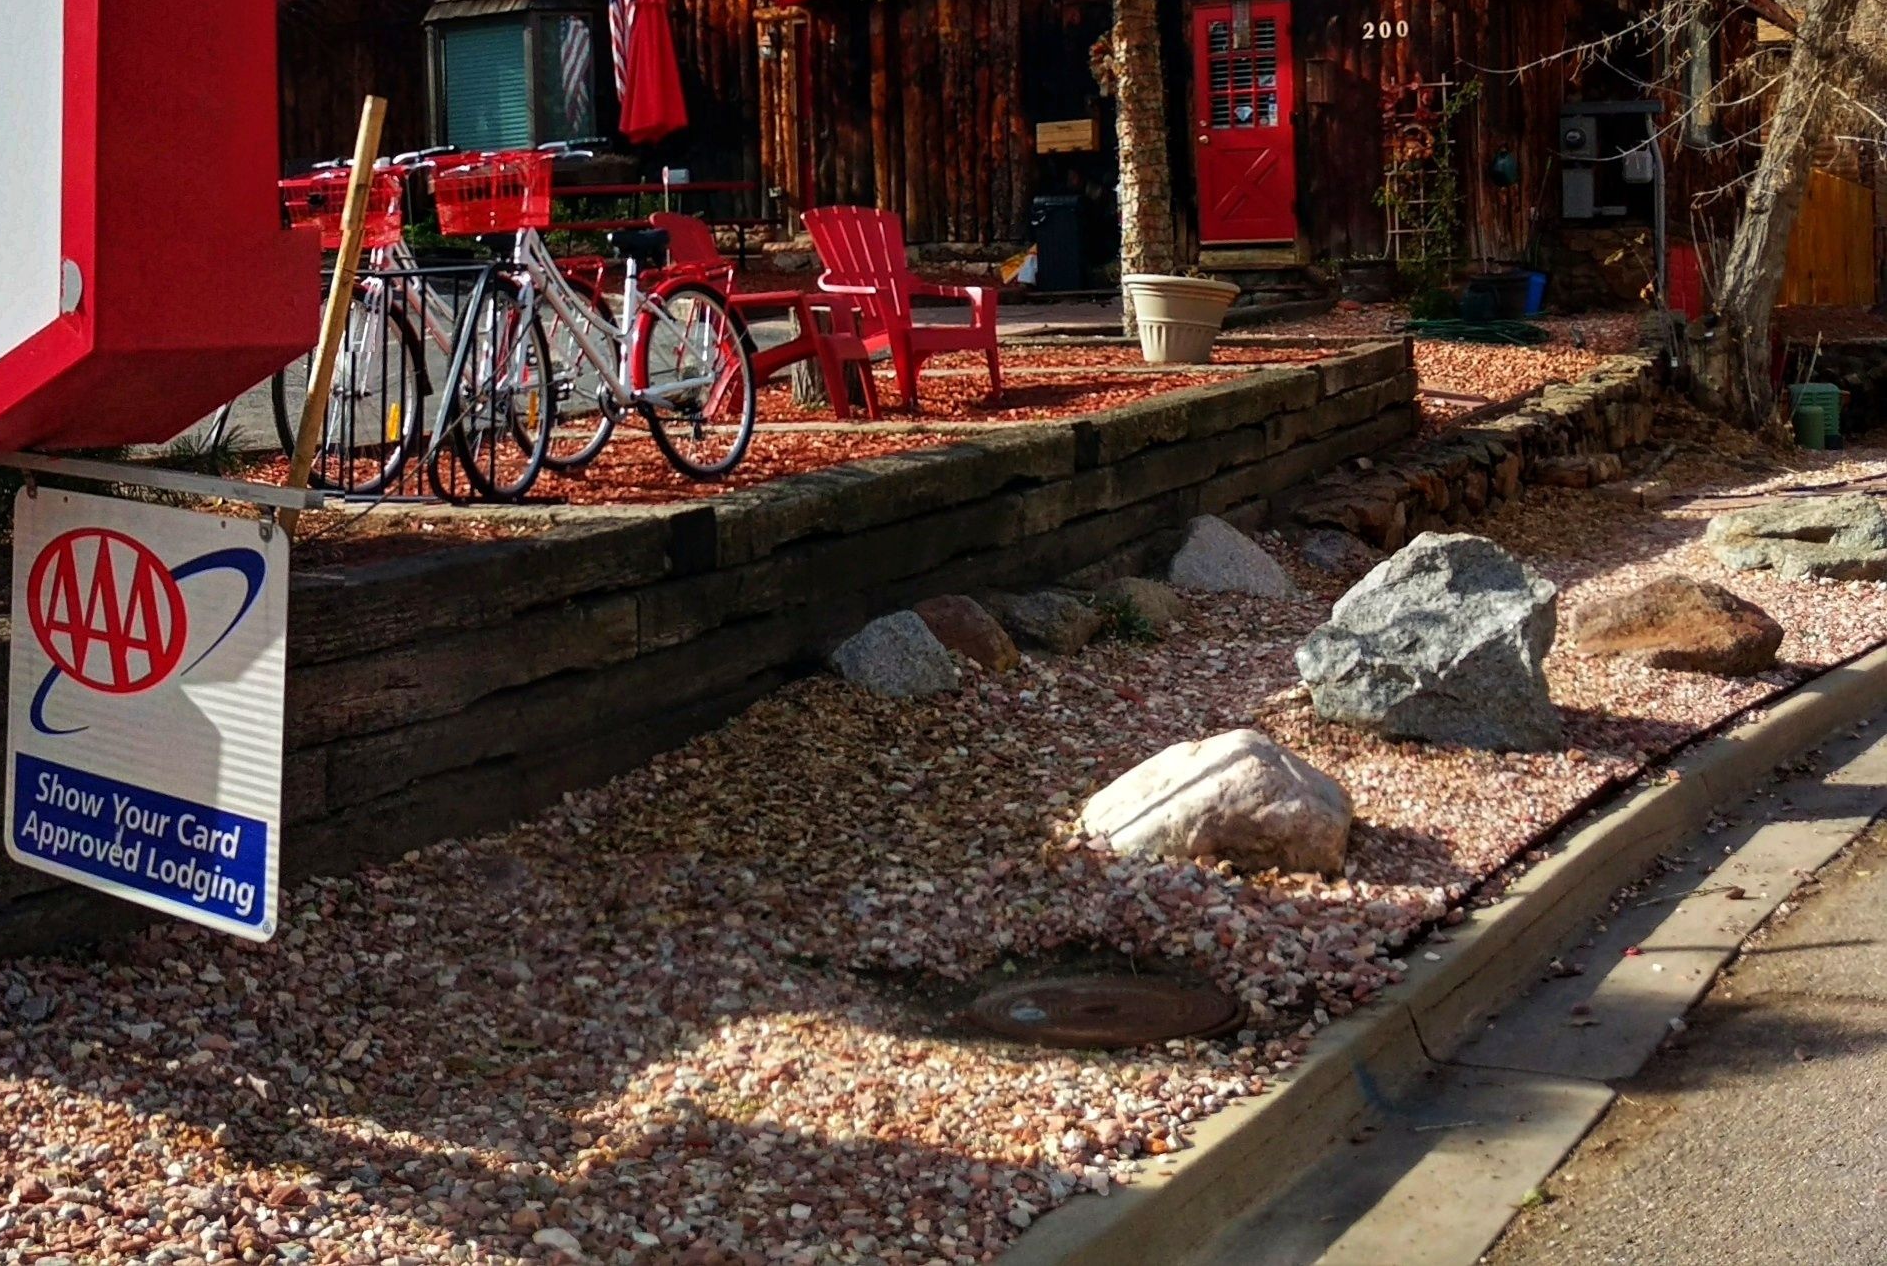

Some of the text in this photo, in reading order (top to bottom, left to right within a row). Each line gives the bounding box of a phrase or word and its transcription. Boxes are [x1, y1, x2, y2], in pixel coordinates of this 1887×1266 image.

[1362, 20, 1409, 40] 200
[35, 530, 179, 691] AAA
[21, 810, 256, 917] Approved Lodging
[35, 771, 241, 860] Show Your Card
